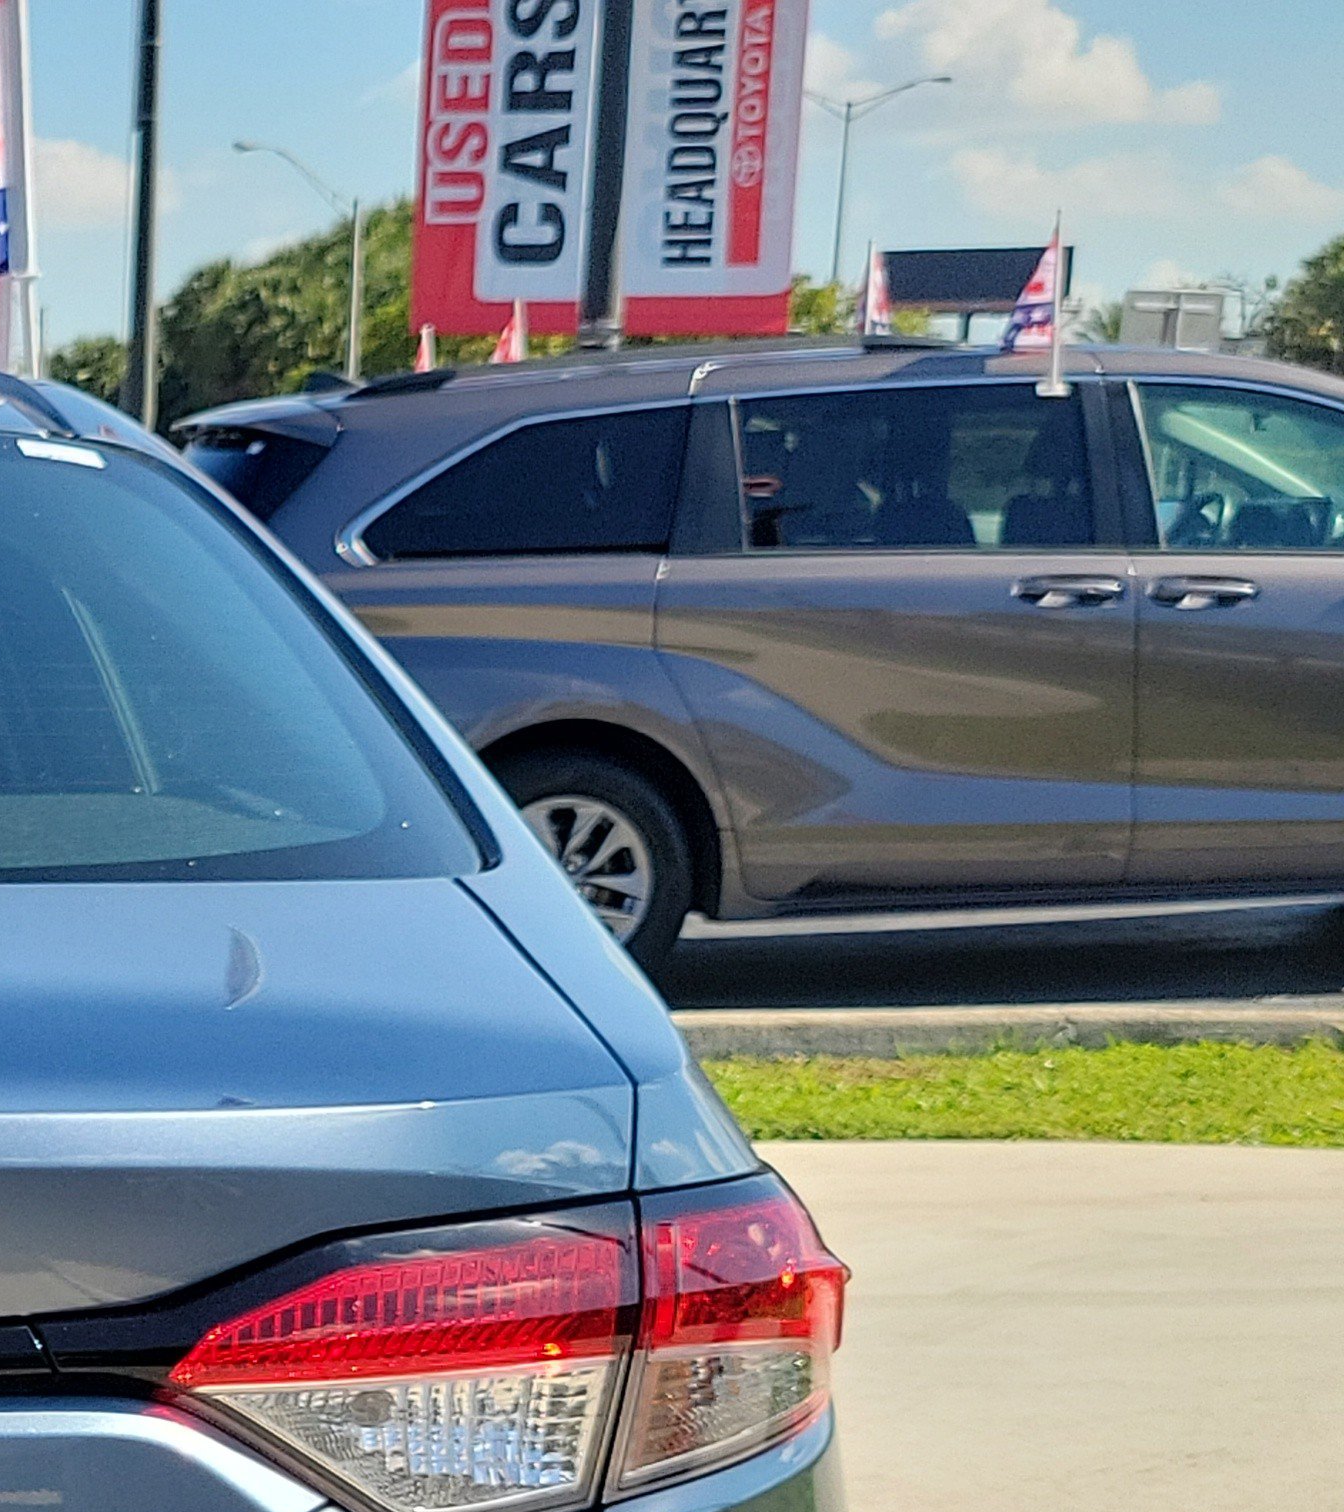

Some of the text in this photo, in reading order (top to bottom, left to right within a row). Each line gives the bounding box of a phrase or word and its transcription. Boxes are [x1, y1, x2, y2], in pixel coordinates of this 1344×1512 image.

[429, 17, 494, 223] USED
[496, 0, 580, 267] CARS
[660, 0, 728, 268] HEADQUAR
[736, 4, 773, 139] TOYOTA
